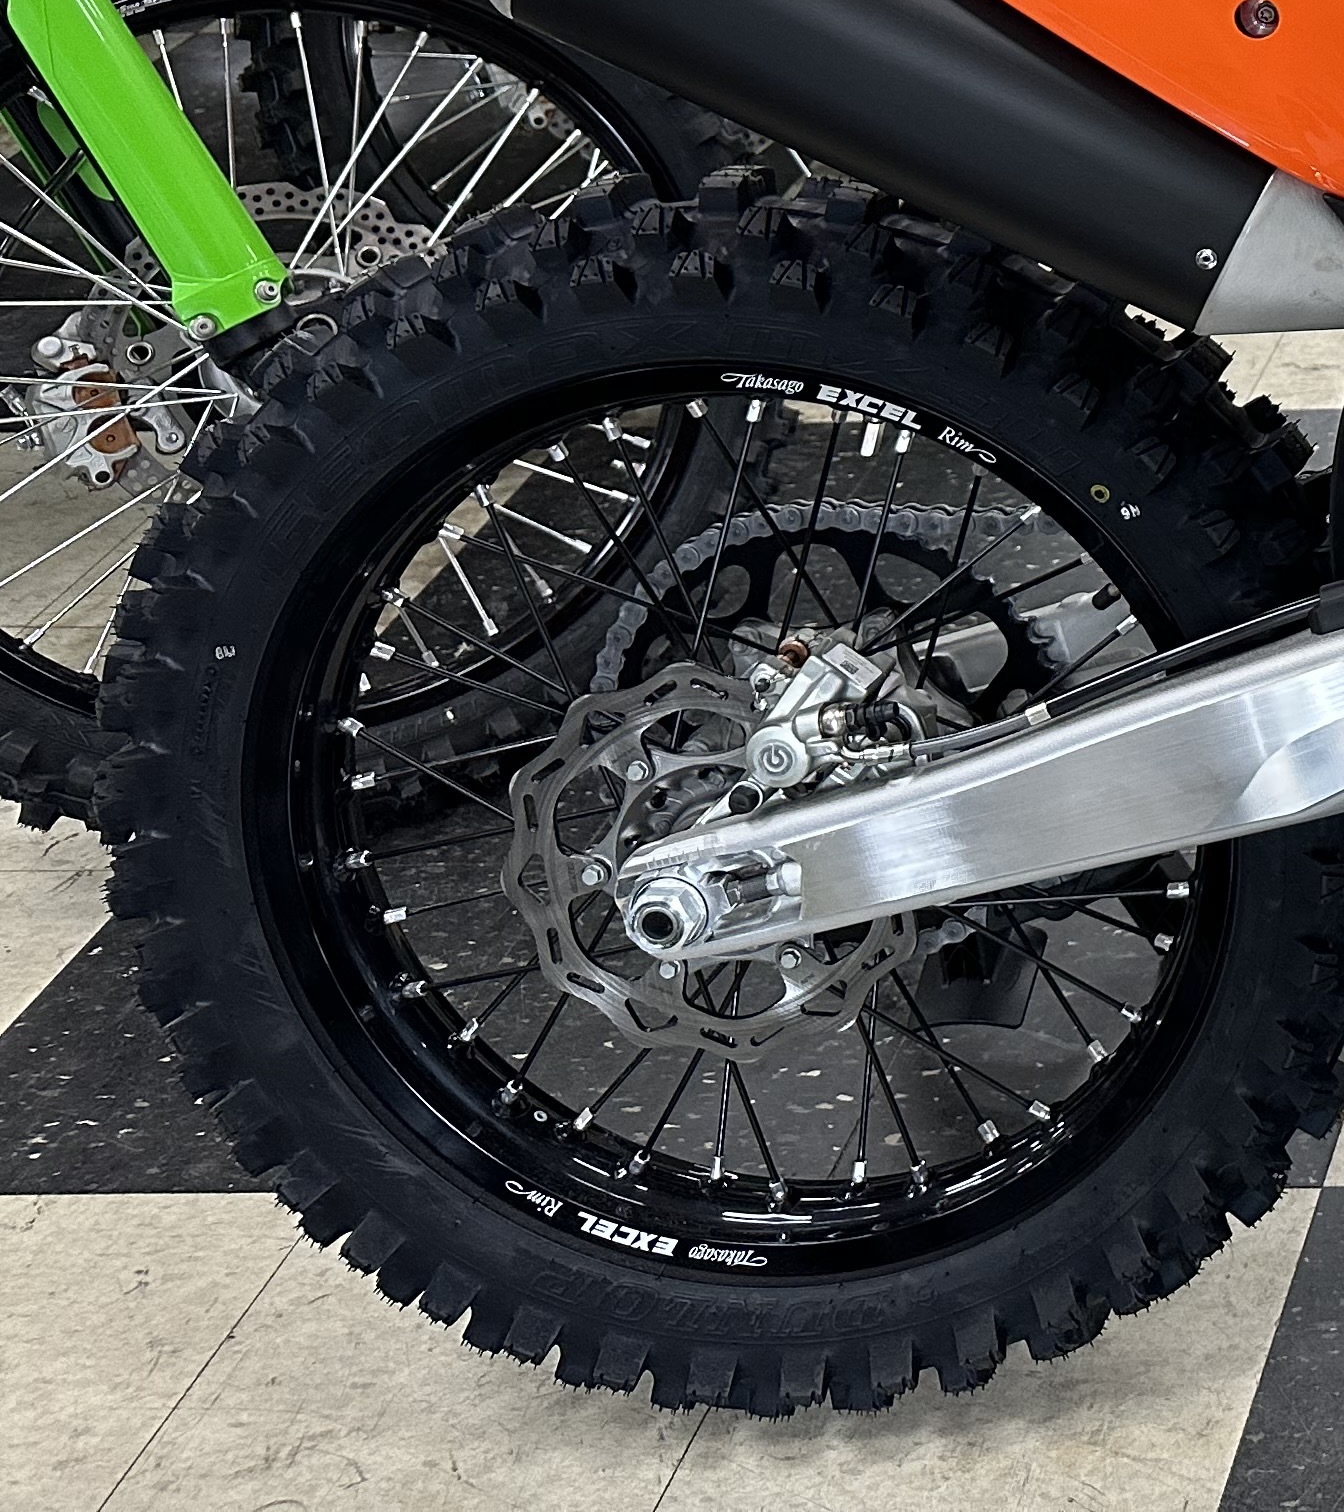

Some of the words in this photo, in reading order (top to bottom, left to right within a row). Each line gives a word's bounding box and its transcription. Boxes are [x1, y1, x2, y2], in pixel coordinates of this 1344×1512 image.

[720, 372, 804, 394] Takasago
[816, 384, 922, 430] EXCEL
[938, 426, 997, 464] Rim
[505, 1180, 563, 1218] Rim
[577, 1211, 679, 1257] EXCEL
[688, 1243, 768, 1267] Takasago
